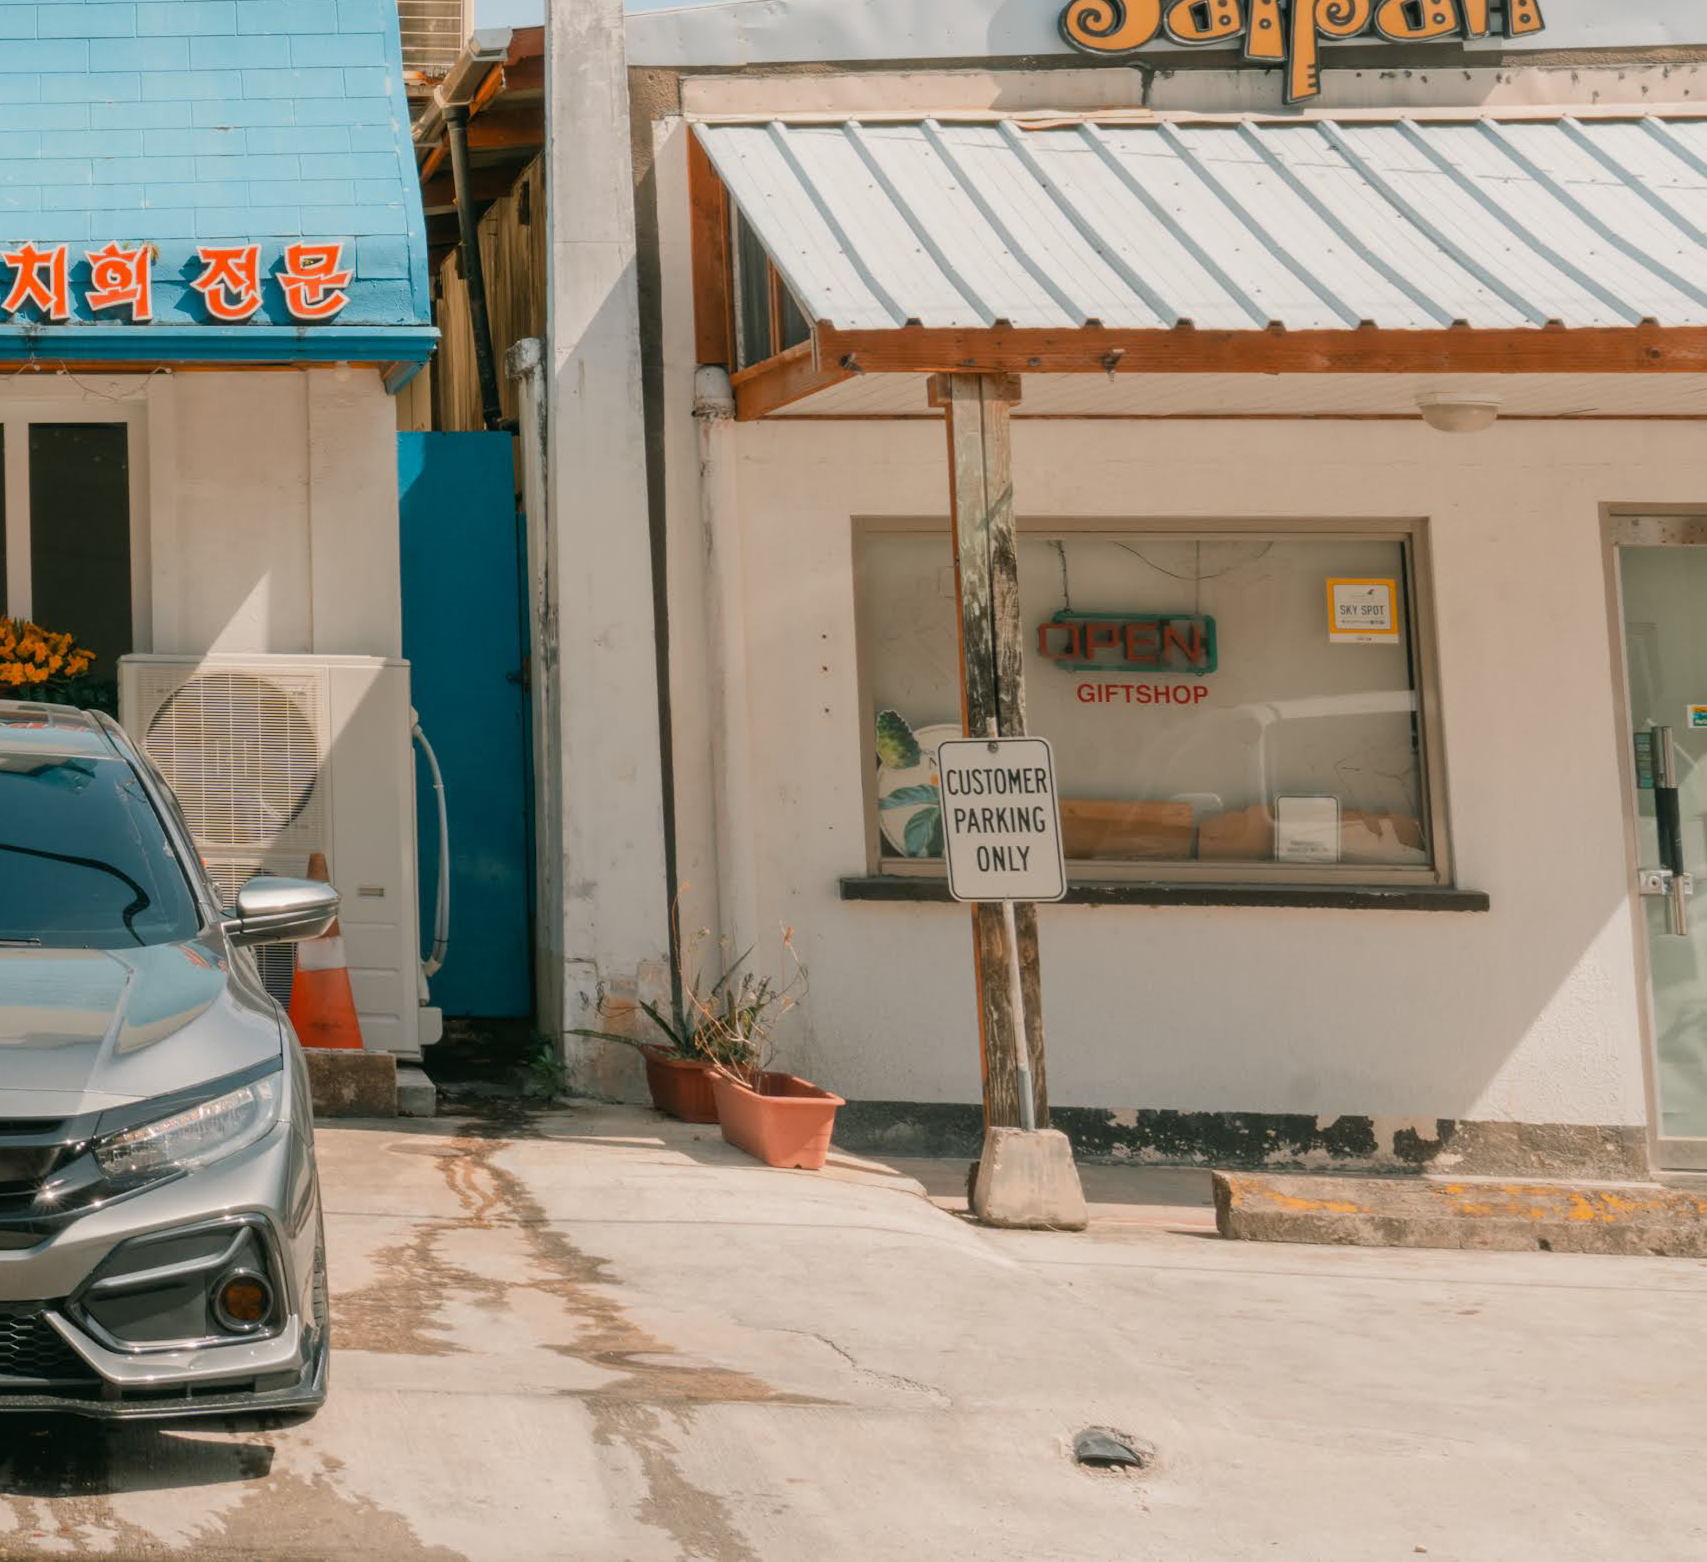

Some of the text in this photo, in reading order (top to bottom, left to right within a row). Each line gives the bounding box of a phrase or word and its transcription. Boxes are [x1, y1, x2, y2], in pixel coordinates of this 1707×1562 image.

[190, 242, 354, 322] 전문
[1339, 604, 1385, 616] SKY SPOT
[1038, 622, 1202, 663] OPEN
[1077, 684, 1209, 705] GIFTSHOP
[946, 768, 1048, 796] CUSTOMER
[954, 806, 1046, 834] PARKING
[977, 846, 1030, 872] ONLY
